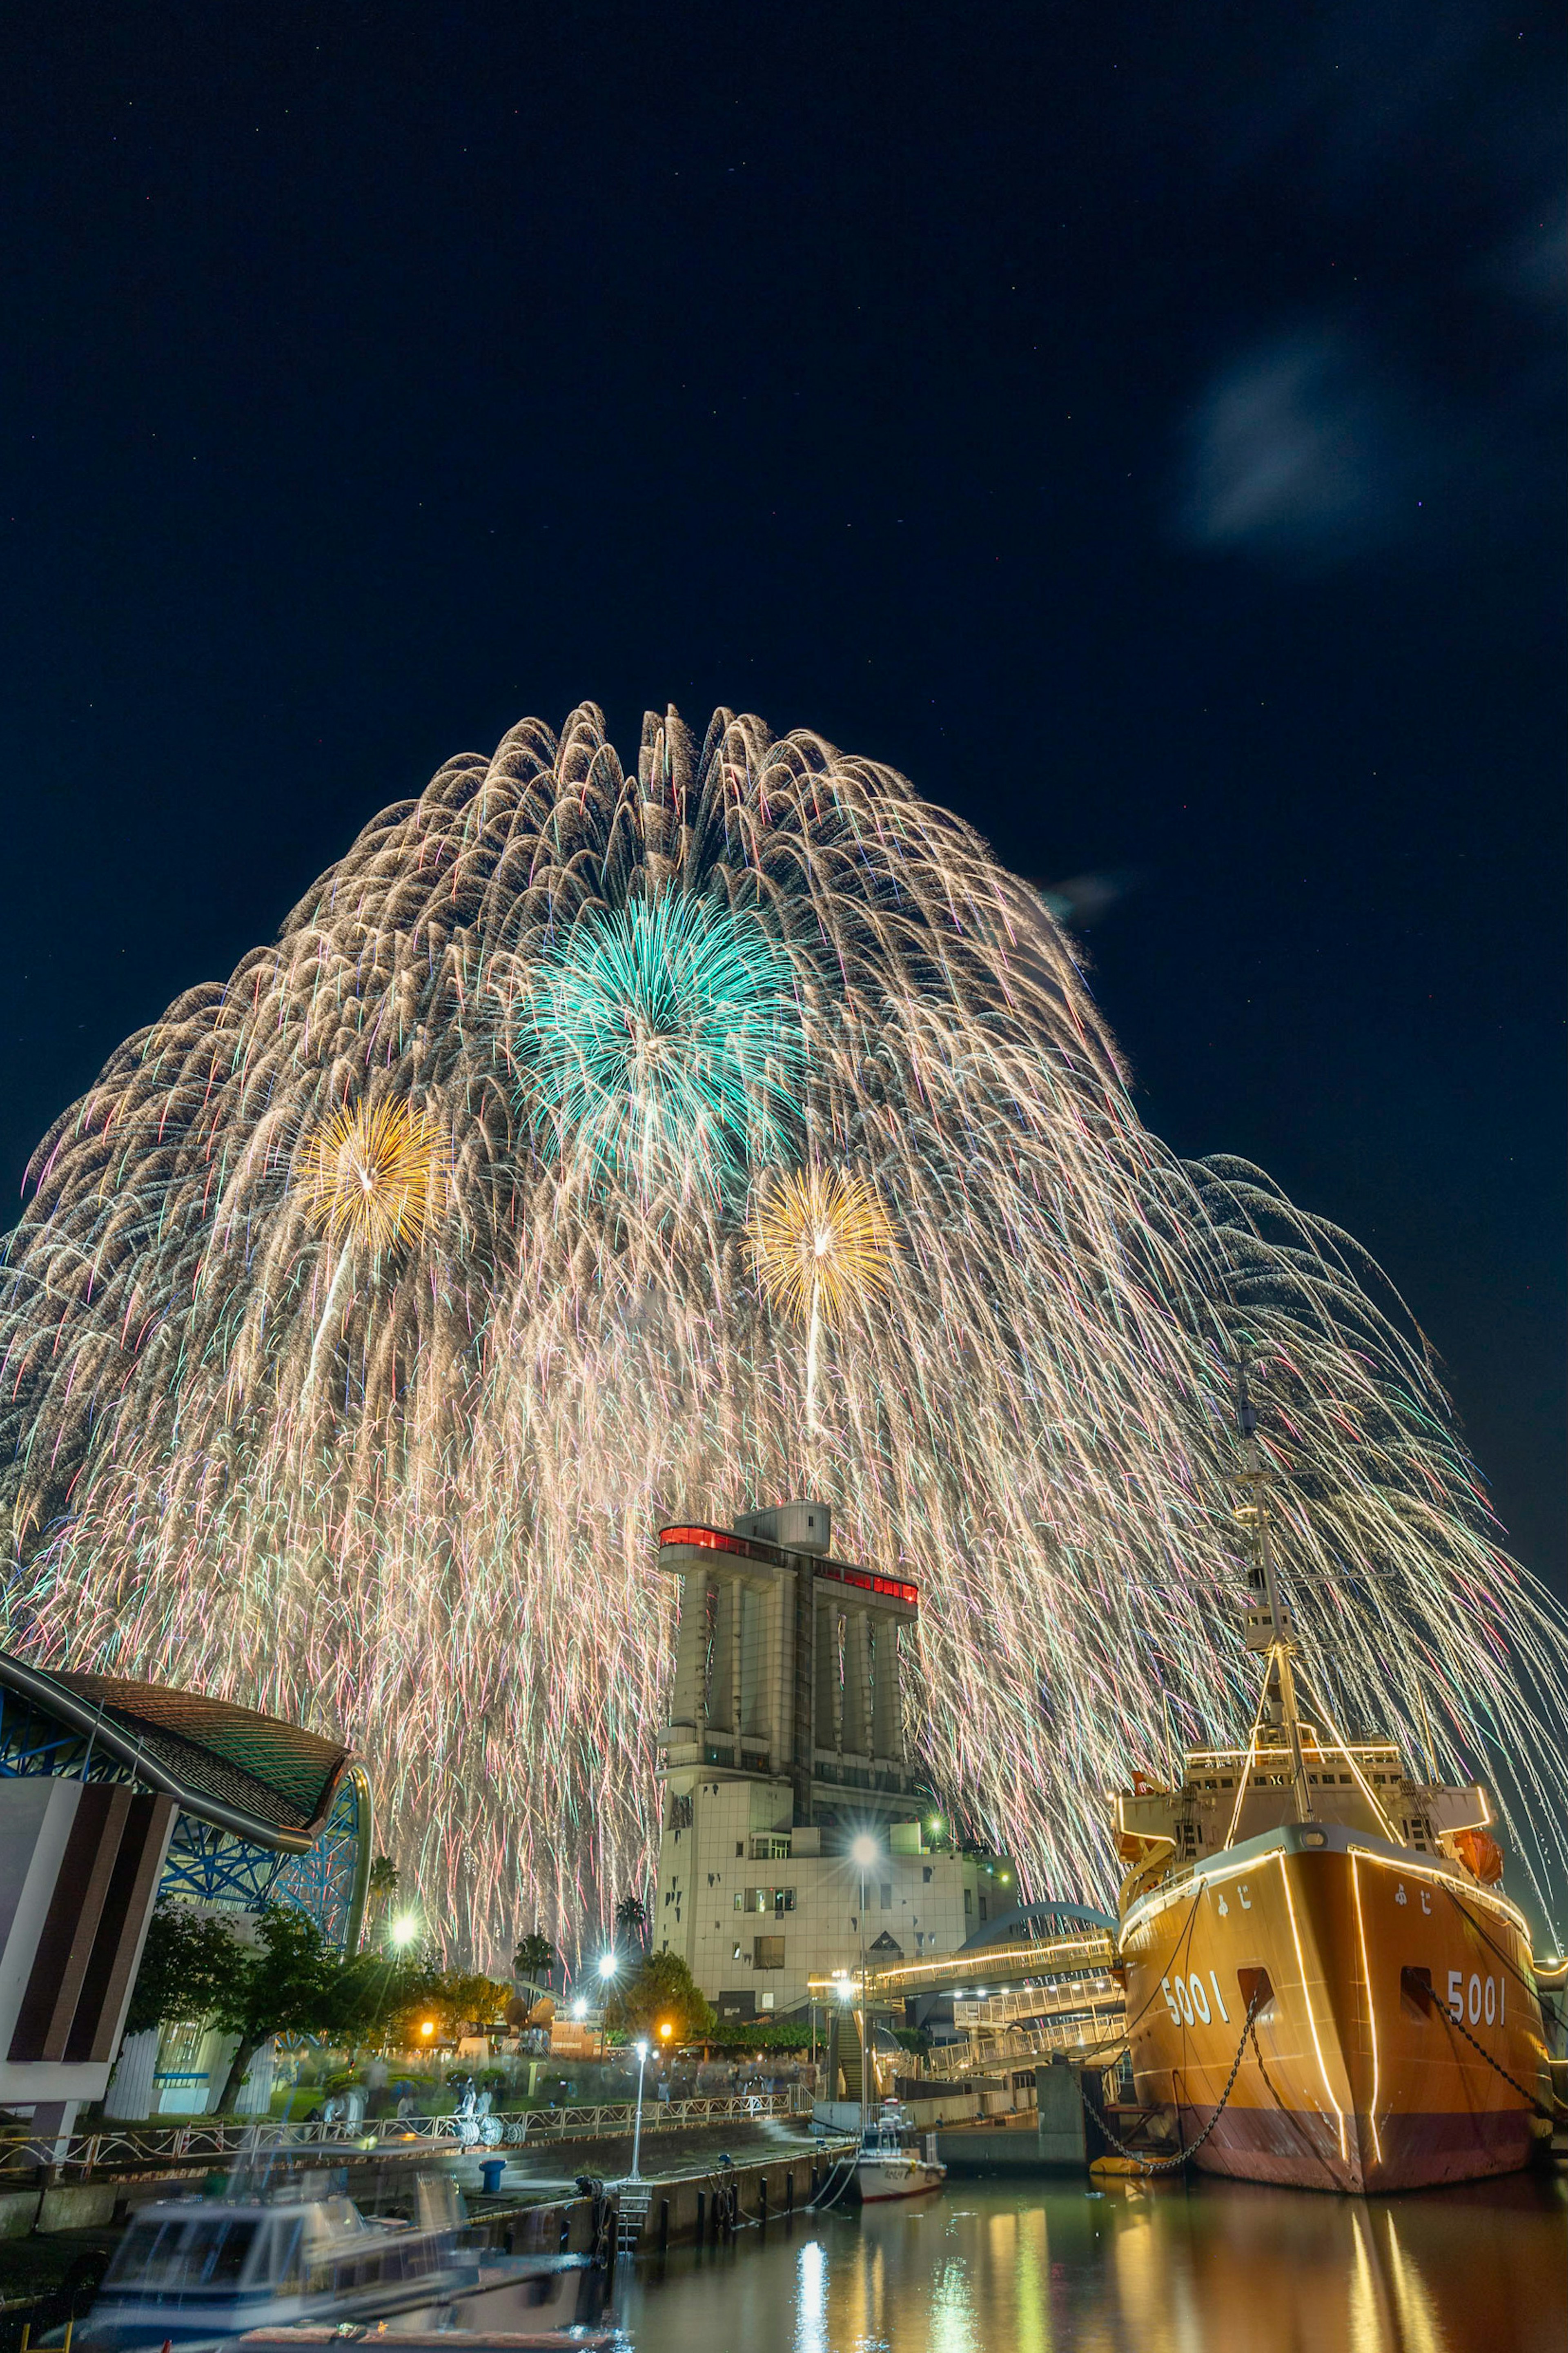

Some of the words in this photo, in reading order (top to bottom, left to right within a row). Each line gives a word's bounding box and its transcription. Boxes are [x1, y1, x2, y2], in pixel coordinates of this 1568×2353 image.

[1395, 1883, 1431, 1915] ふじ
[1161, 1970, 1229, 2026] 5001
[1448, 1970, 1505, 2026] 5001
